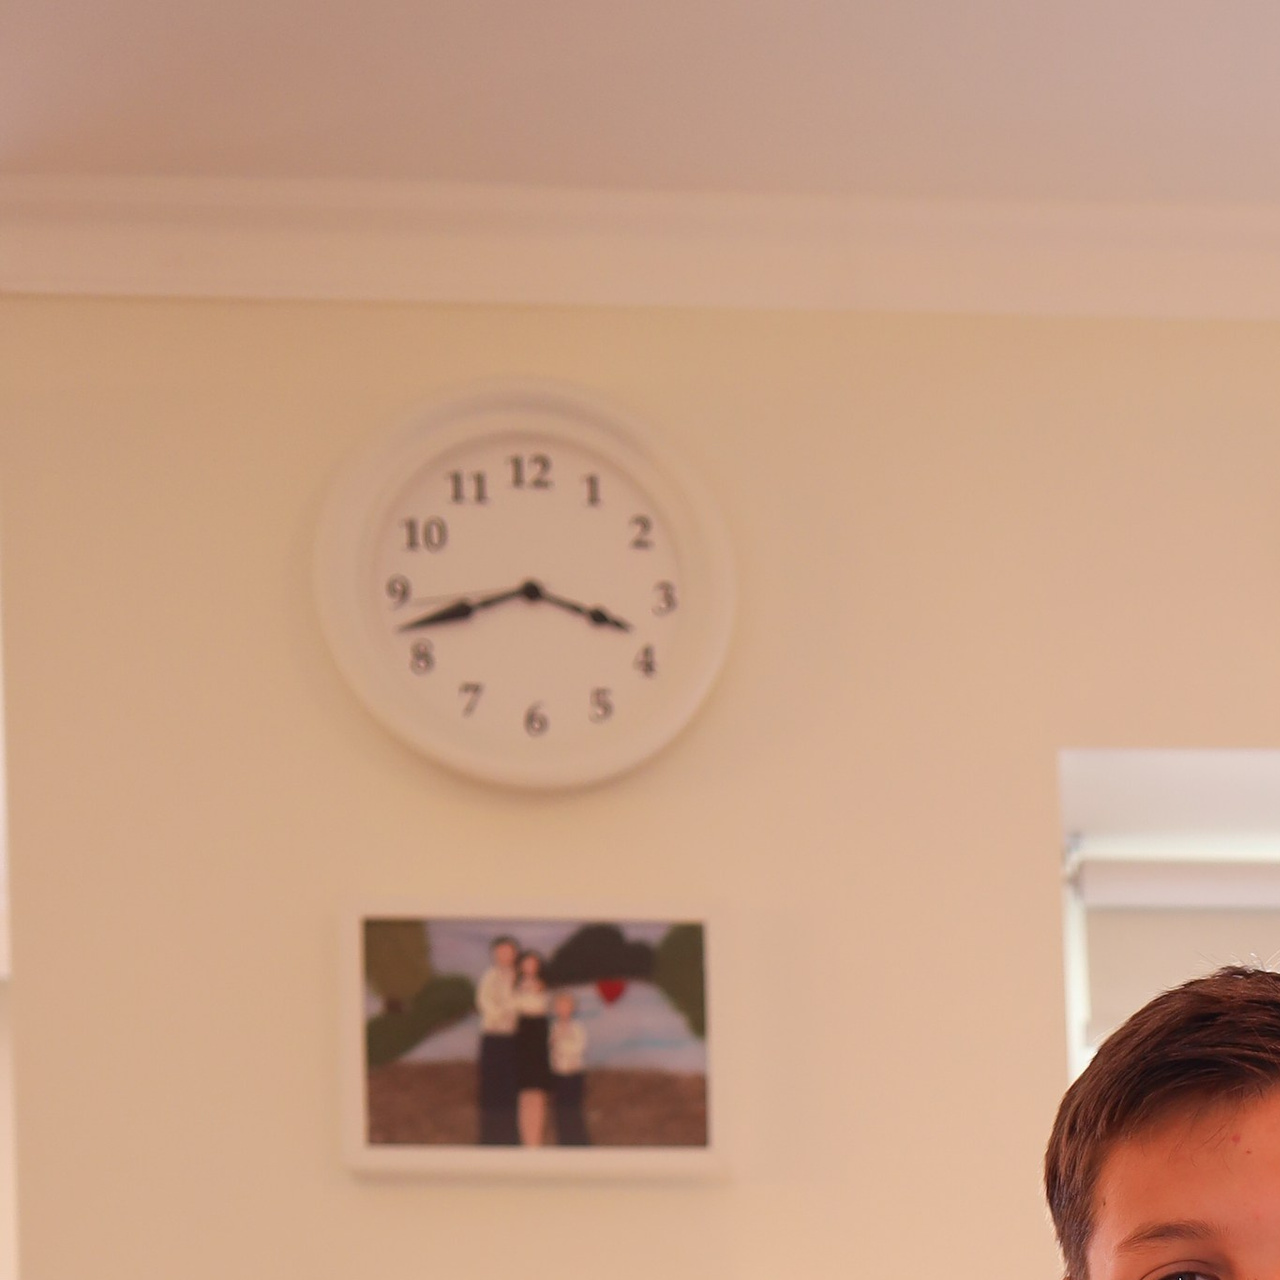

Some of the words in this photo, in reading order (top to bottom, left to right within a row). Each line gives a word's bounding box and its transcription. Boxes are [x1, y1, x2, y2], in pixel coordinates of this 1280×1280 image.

[448, 470, 488, 505] 11
[508, 454, 552, 490] 12
[586, 474, 600, 507] 1
[402, 517, 449, 553] 10
[630, 514, 655, 549] 2
[386, 574, 412, 610] 9
[652, 580, 677, 616] 3
[410, 638, 435, 676] 8
[634, 643, 658, 679] 4
[459, 681, 484, 718] 7
[590, 687, 615, 724] 5
[524, 700, 549, 738] 6
